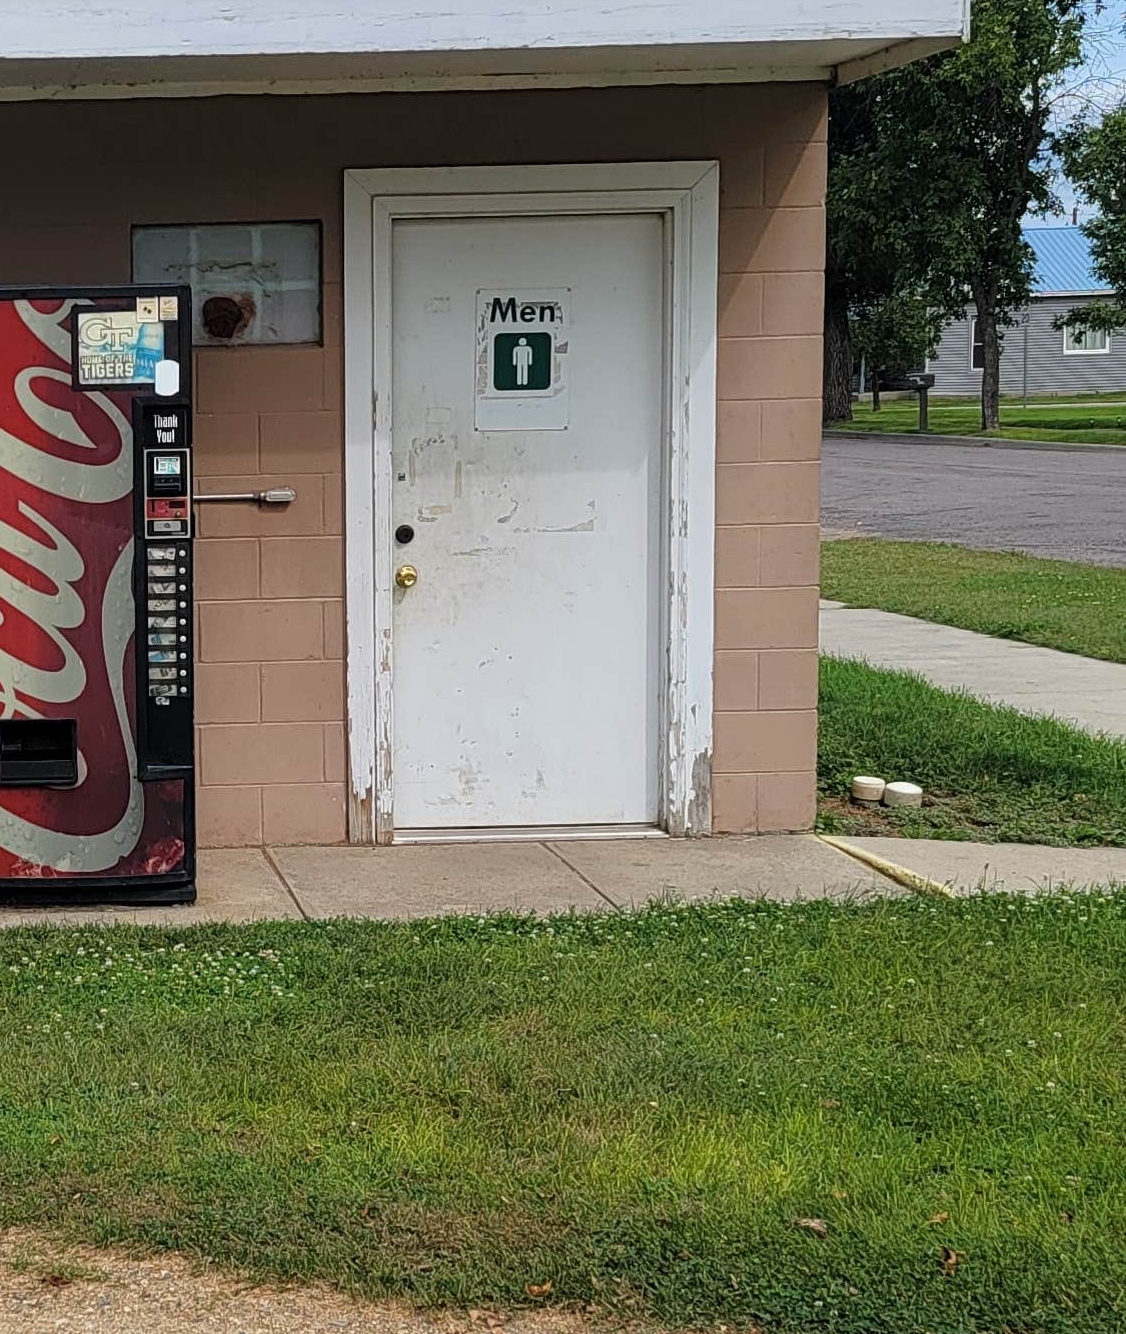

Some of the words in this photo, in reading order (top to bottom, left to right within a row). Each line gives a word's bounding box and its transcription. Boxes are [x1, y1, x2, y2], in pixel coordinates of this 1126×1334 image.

[489, 296, 555, 323] Men
[81, 362, 134, 379] TIGERS
[153, 414, 179, 429] Thank
[156, 429, 176, 444] You!
